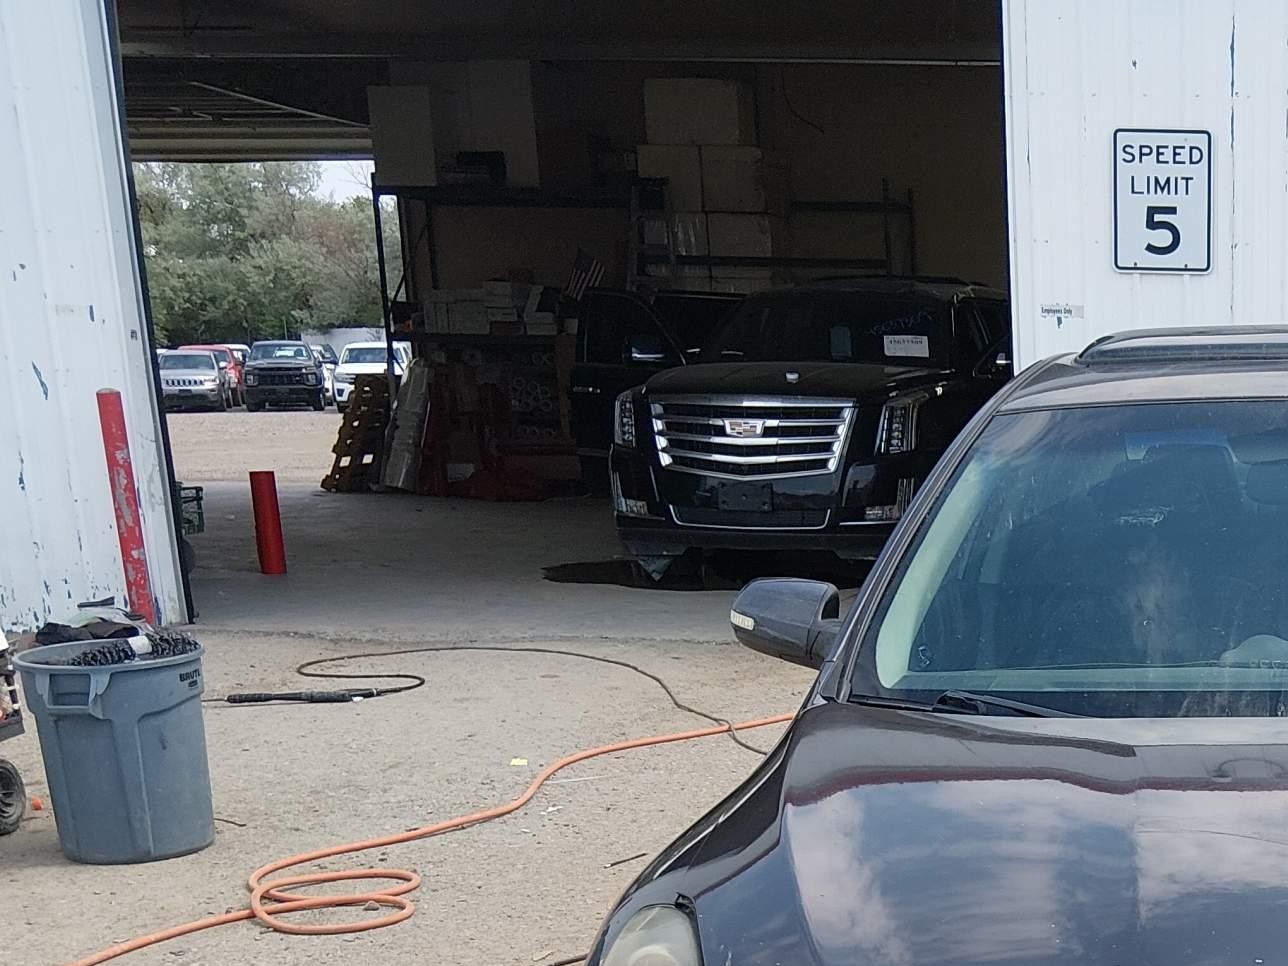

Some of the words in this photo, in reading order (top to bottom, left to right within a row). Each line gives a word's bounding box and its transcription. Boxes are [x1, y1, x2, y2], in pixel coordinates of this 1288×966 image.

[1122, 144, 1204, 165] SPEED
[1131, 176, 1194, 195] LIMIT
[1144, 206, 1182, 255] 5
